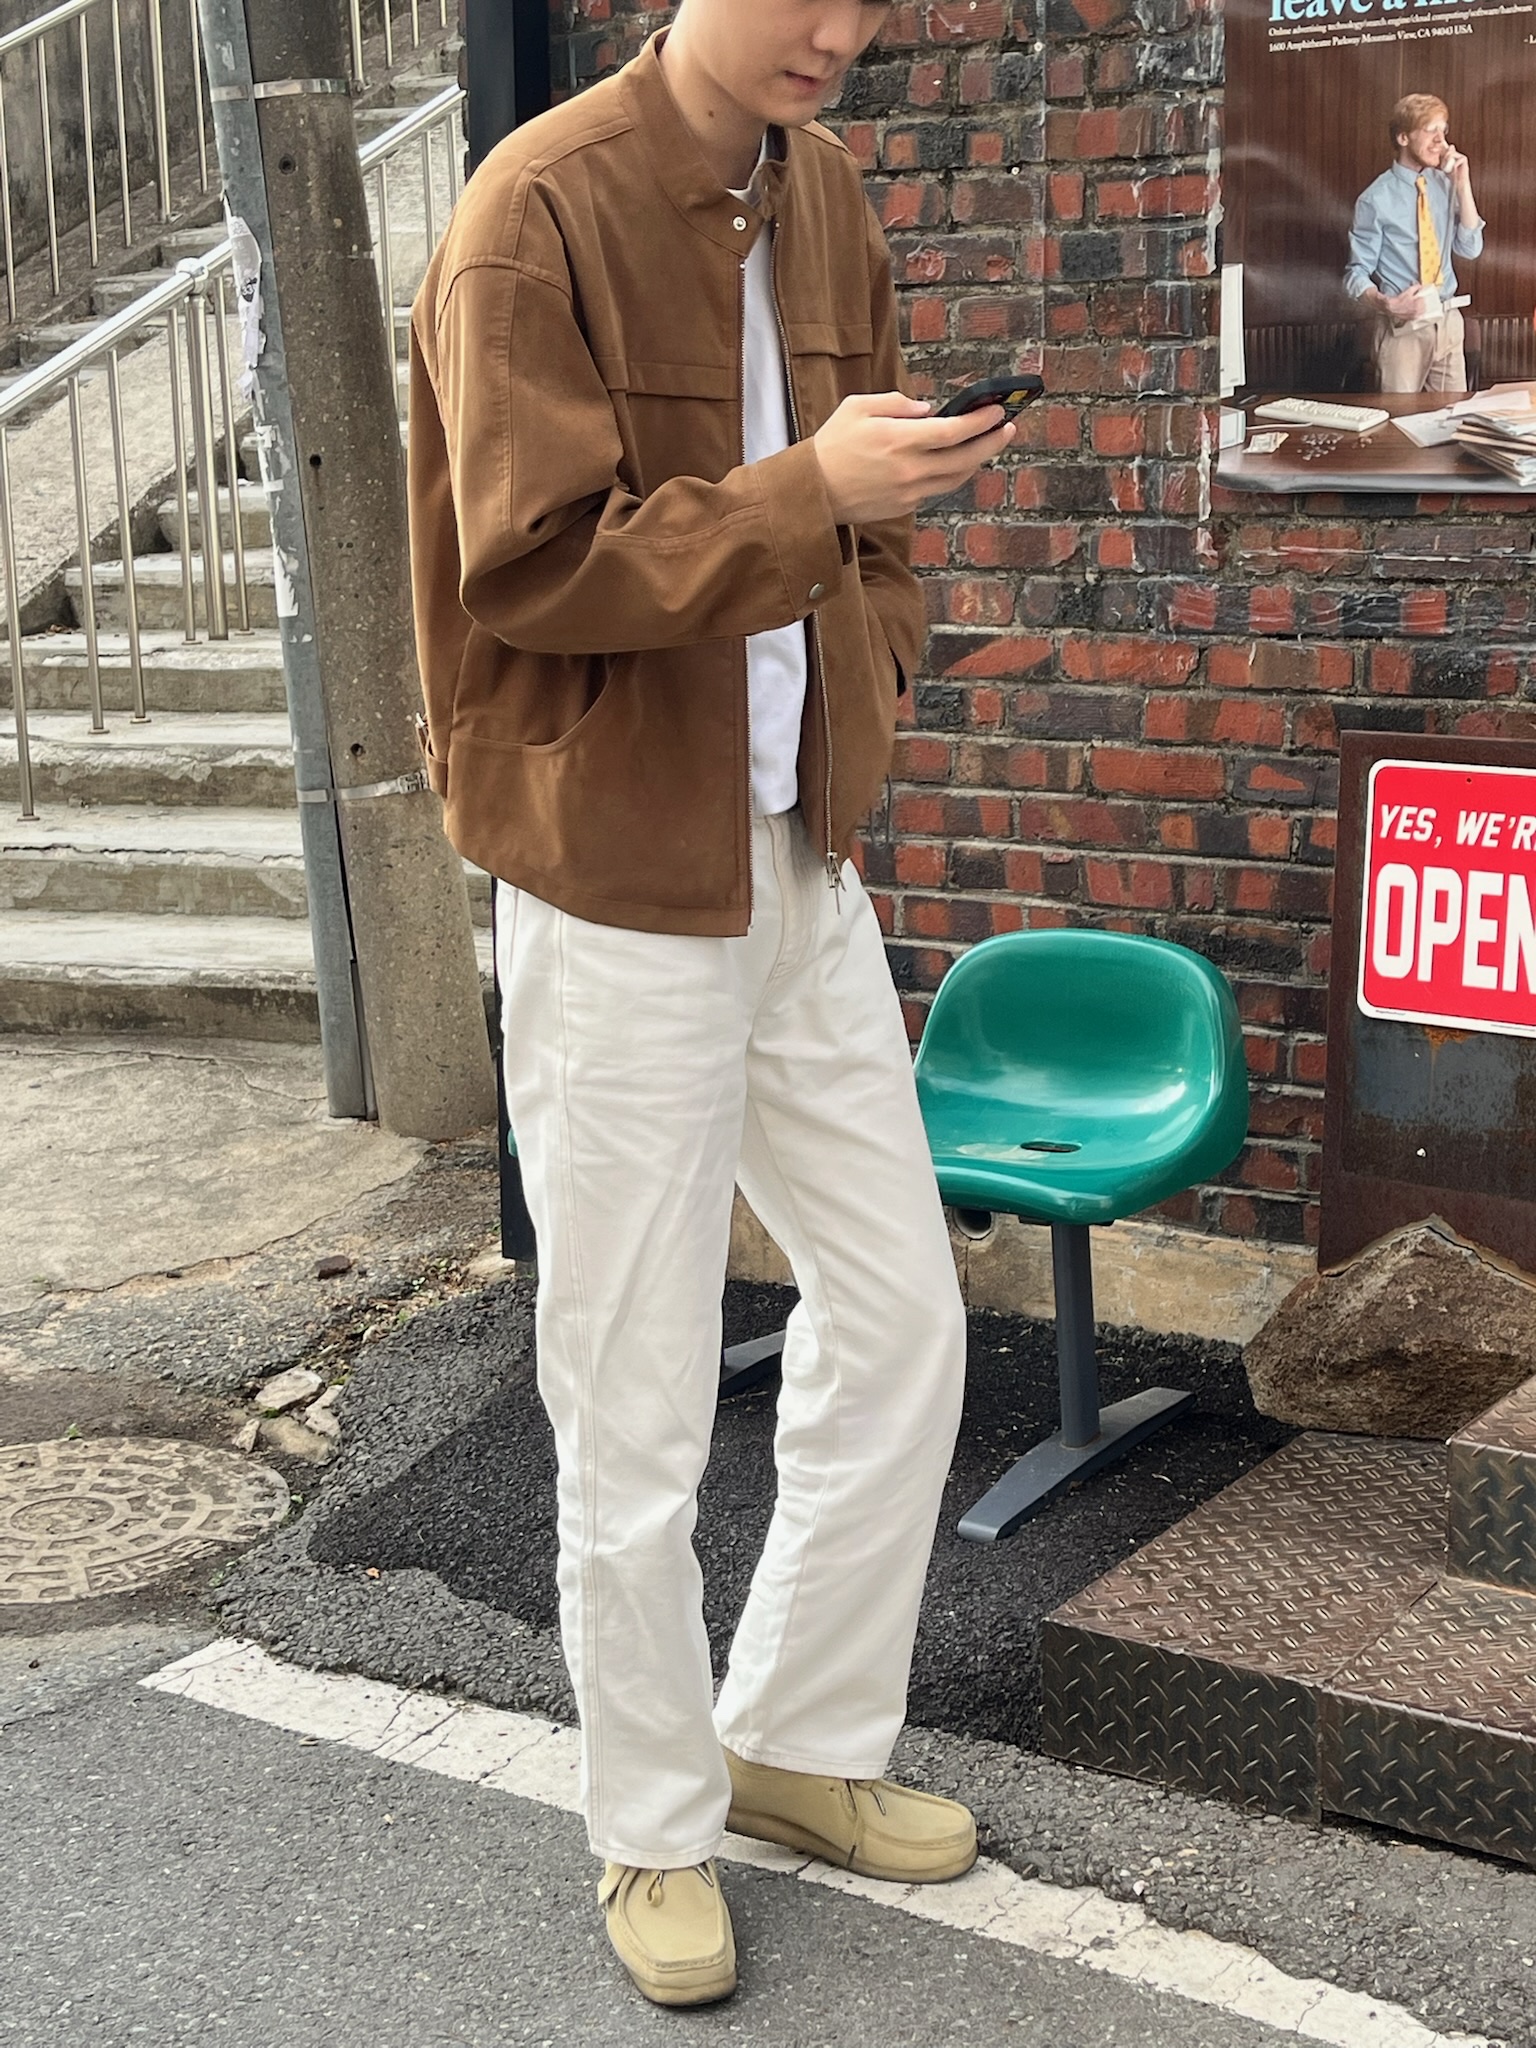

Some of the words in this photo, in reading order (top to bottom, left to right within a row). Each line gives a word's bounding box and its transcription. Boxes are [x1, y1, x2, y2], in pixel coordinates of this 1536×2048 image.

[1268, 42, 1285, 52] 1600
[1332, 35, 1361, 46] Parkway
[1361, 32, 1396, 43] Mountain
[1417, 28, 1431, 38] CA
[1453, 24, 1473, 34] USA
[1379, 804, 1442, 848] YES,
[1456, 810, 1536, 851] WE'R
[1373, 862, 1536, 995] OPEN
